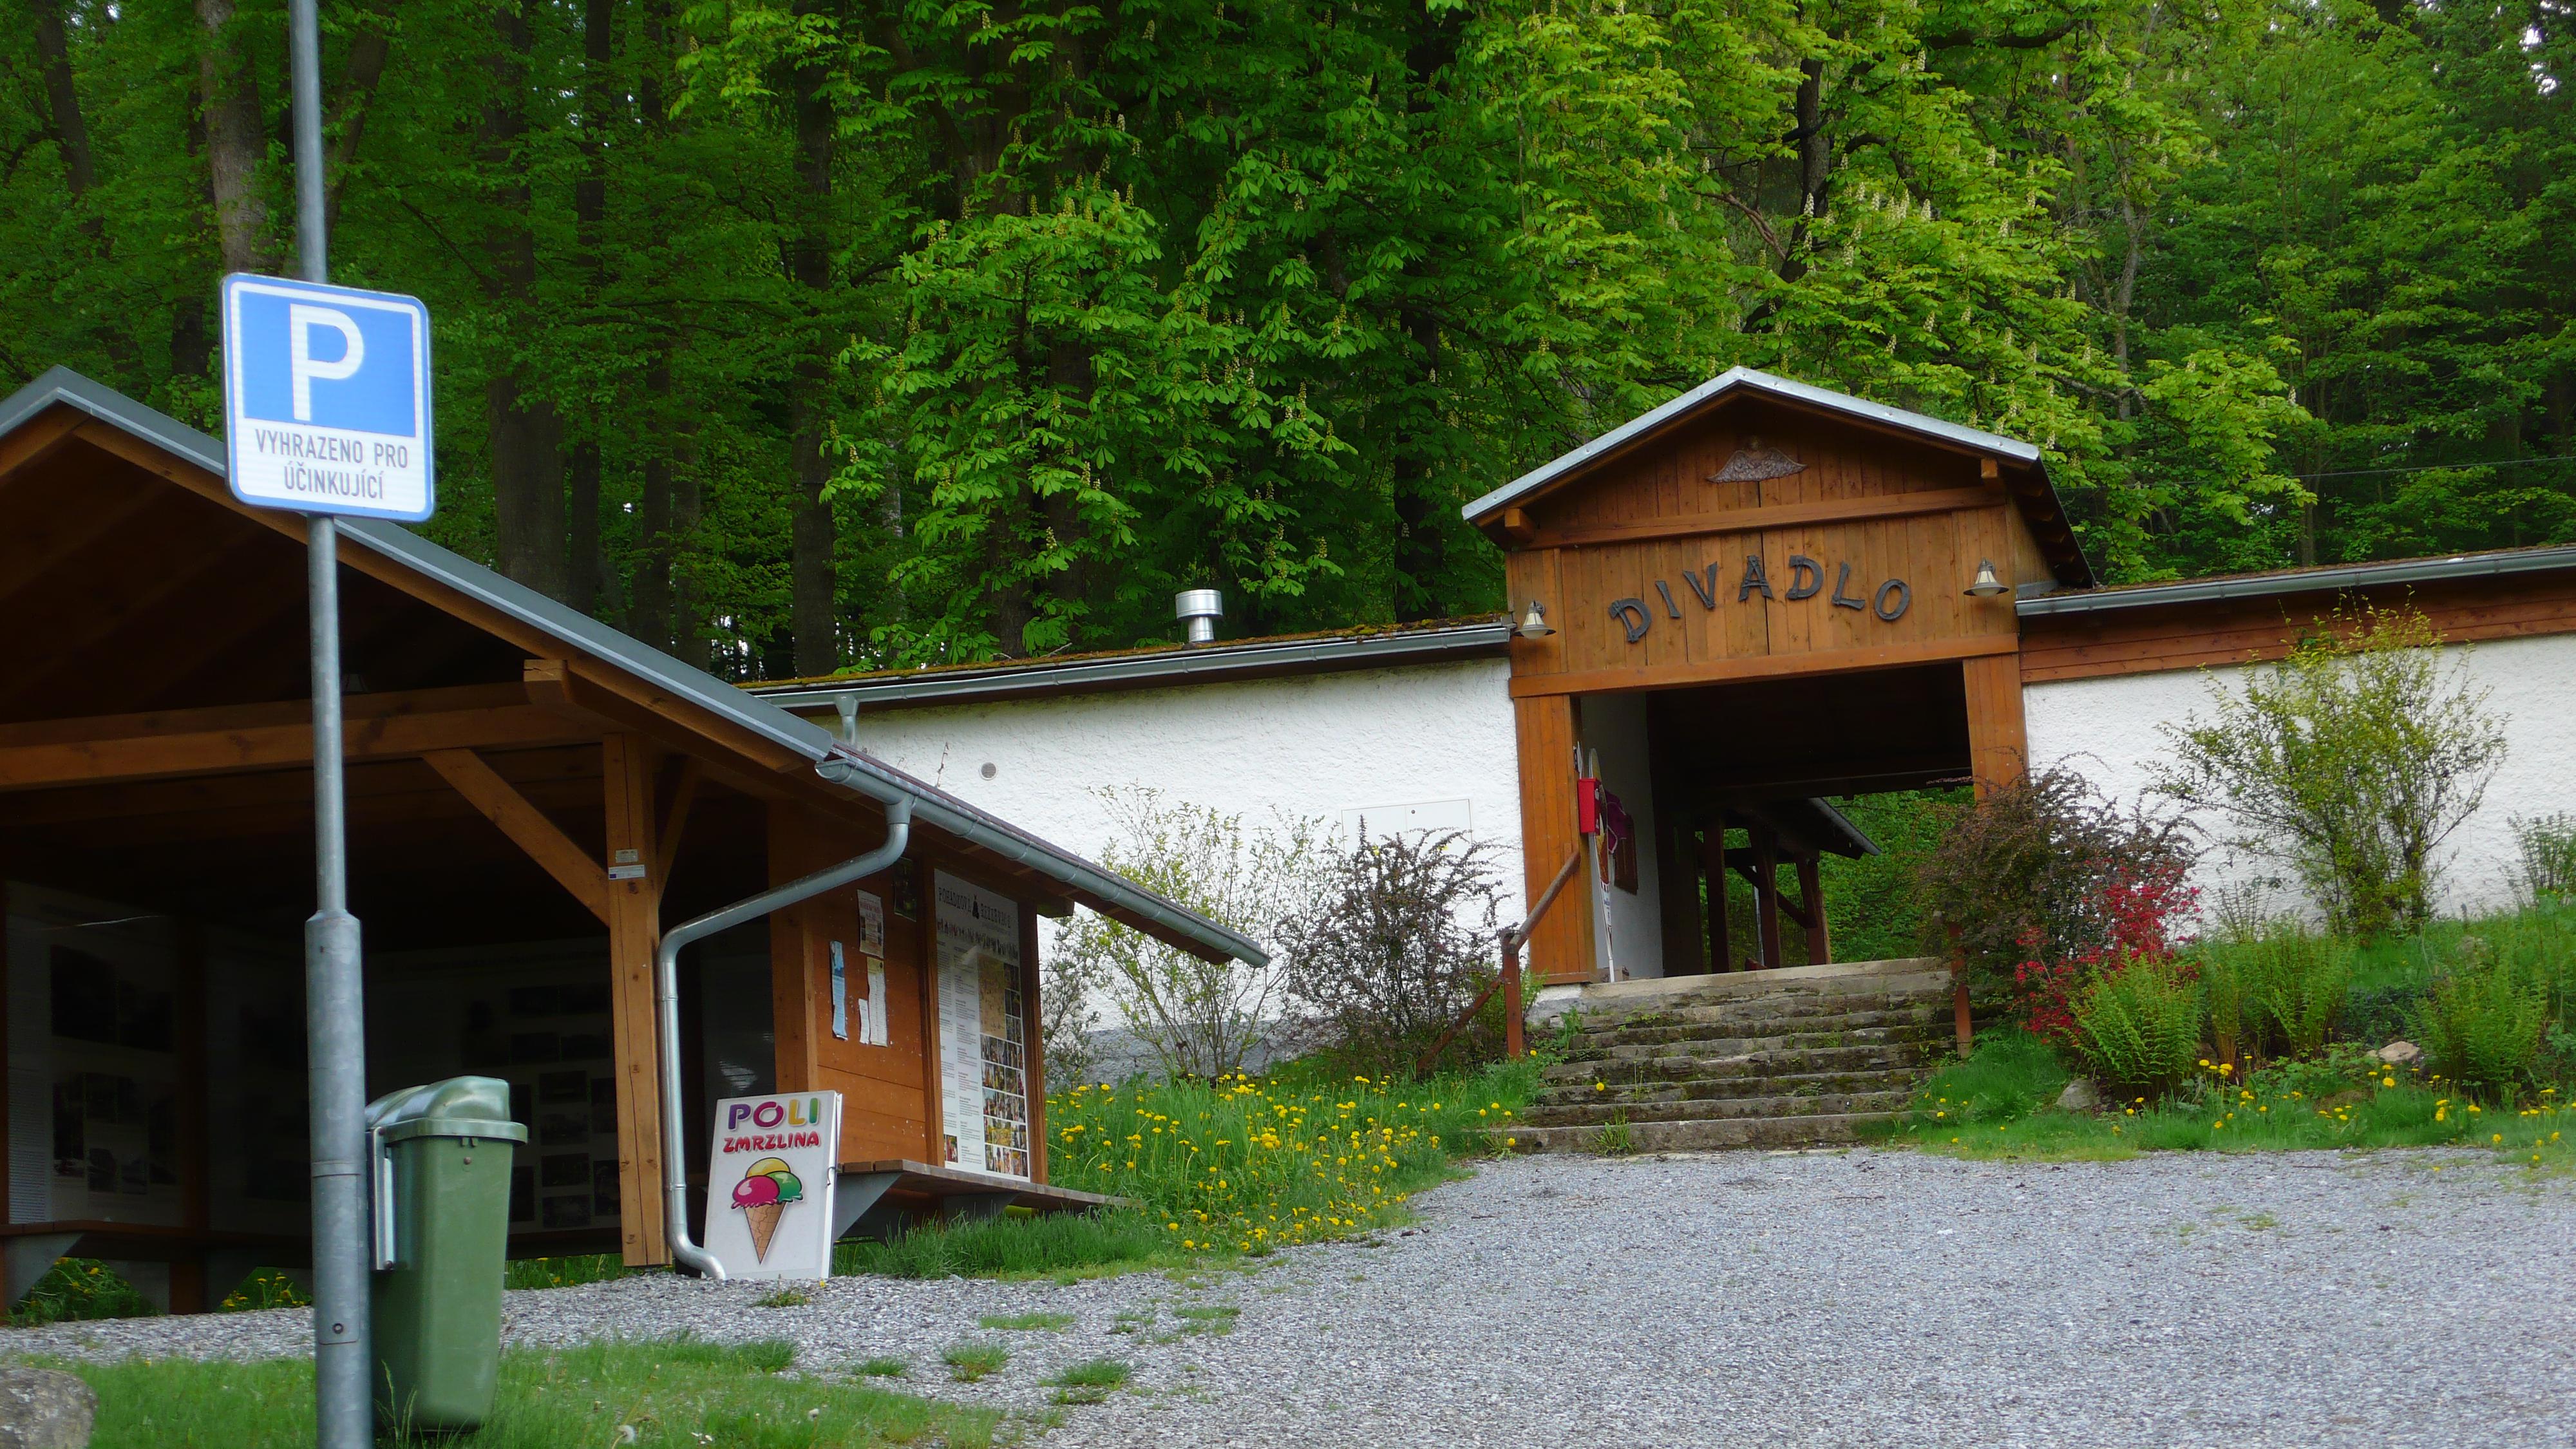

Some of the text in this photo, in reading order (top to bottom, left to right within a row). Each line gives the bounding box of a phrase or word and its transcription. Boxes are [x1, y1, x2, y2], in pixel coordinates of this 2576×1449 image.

[290, 303, 364, 421] P
[255, 428, 408, 469] VYHRAZENO PRO
[283, 460, 384, 500] ÚČINKUJÍCÍ
[1608, 554, 1910, 643] DIVADLO
[728, 1097, 819, 1130] POLI
[723, 1130, 820, 1153] ZMRZLINA
